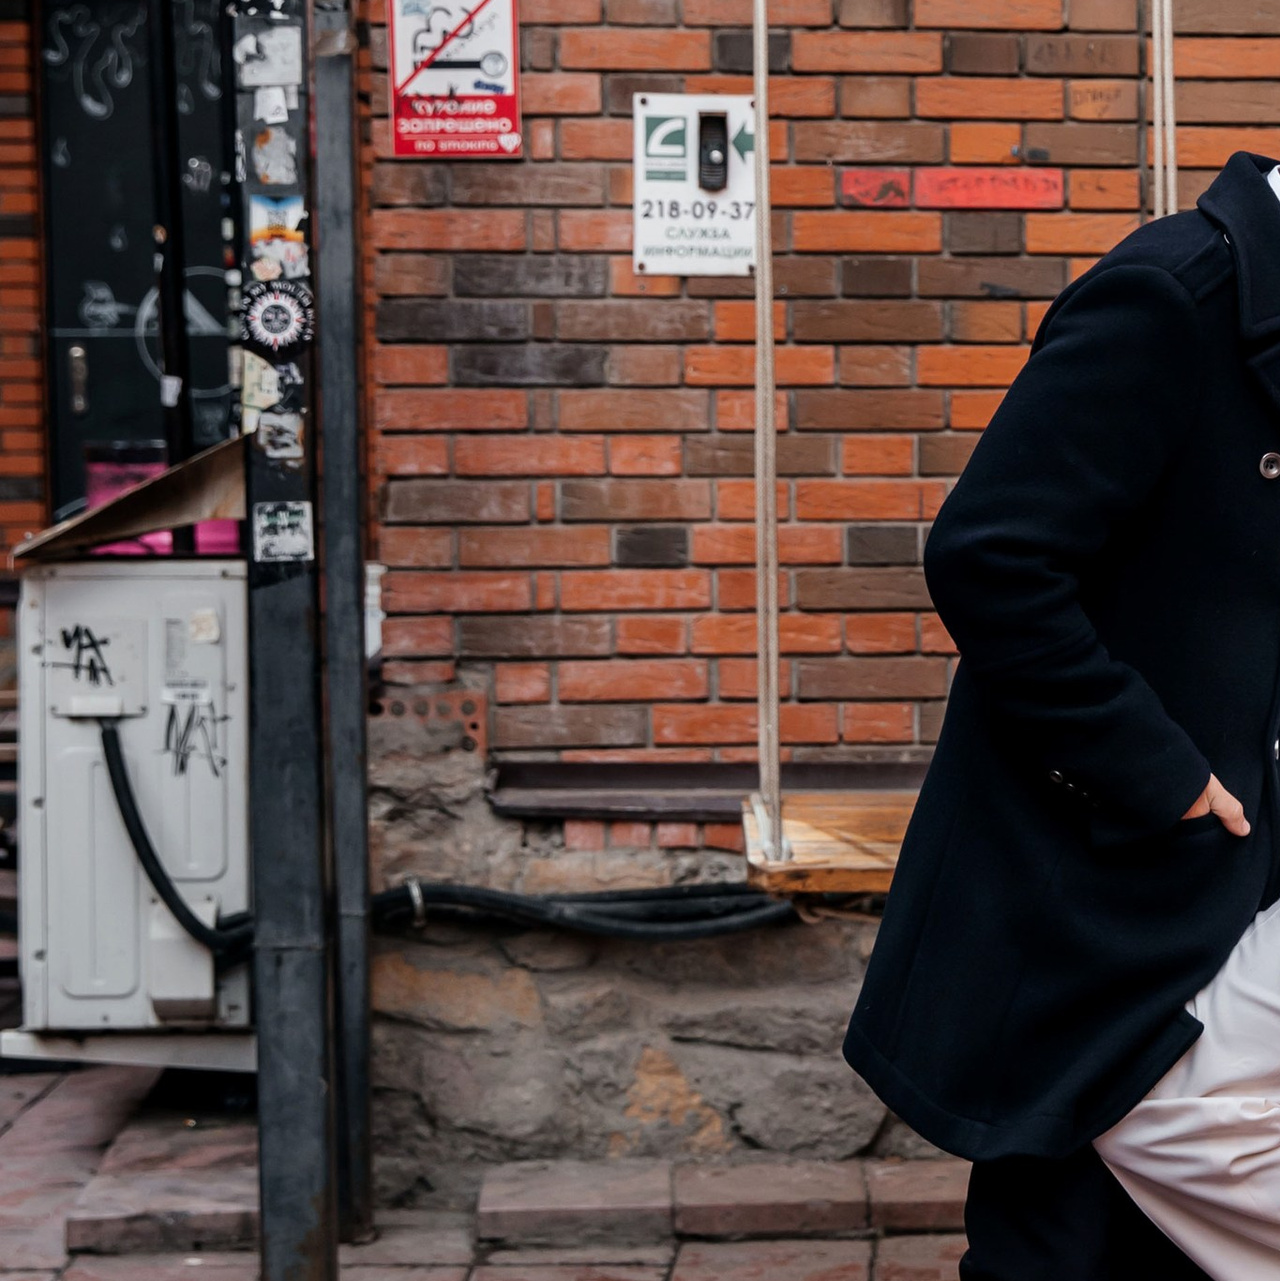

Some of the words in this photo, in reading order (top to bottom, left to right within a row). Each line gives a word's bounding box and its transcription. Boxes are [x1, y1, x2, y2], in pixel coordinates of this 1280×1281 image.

[415, 139, 436, 152] no
[642, 200, 755, 220] 218-09-37
[665, 226, 731, 239] СЛУЖБА
[643, 245, 753, 258] ИНФОРМАЦИИ
